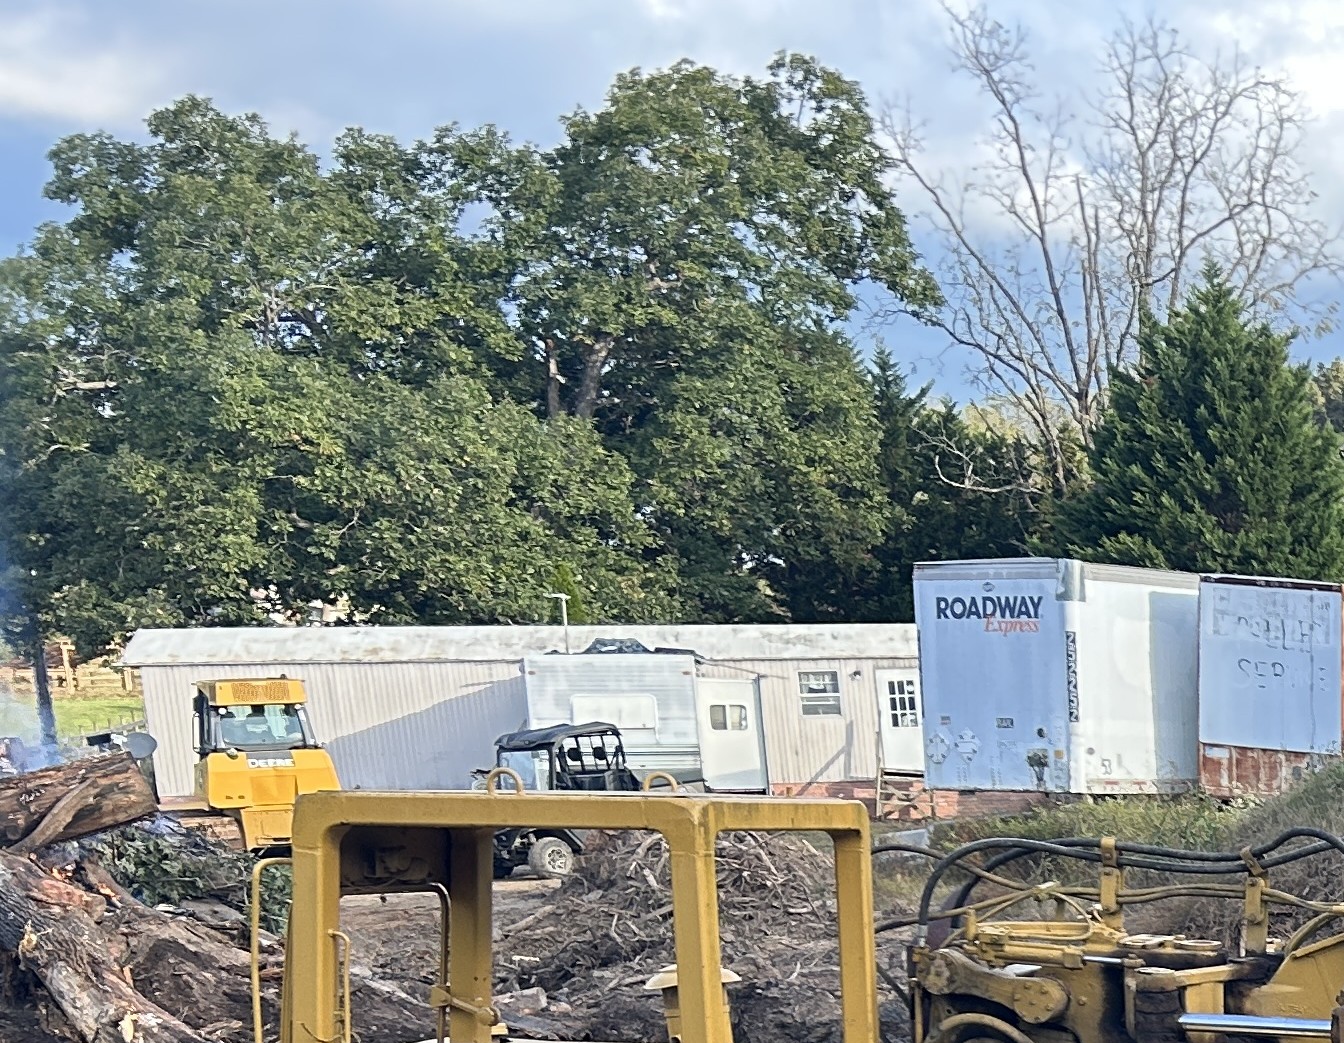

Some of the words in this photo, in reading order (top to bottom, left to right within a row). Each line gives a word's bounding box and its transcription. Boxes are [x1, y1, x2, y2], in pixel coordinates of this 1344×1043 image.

[936, 596, 1043, 619] ROADWAY
[984, 615, 1040, 637] Express
[248, 758, 295, 768] DEERE
